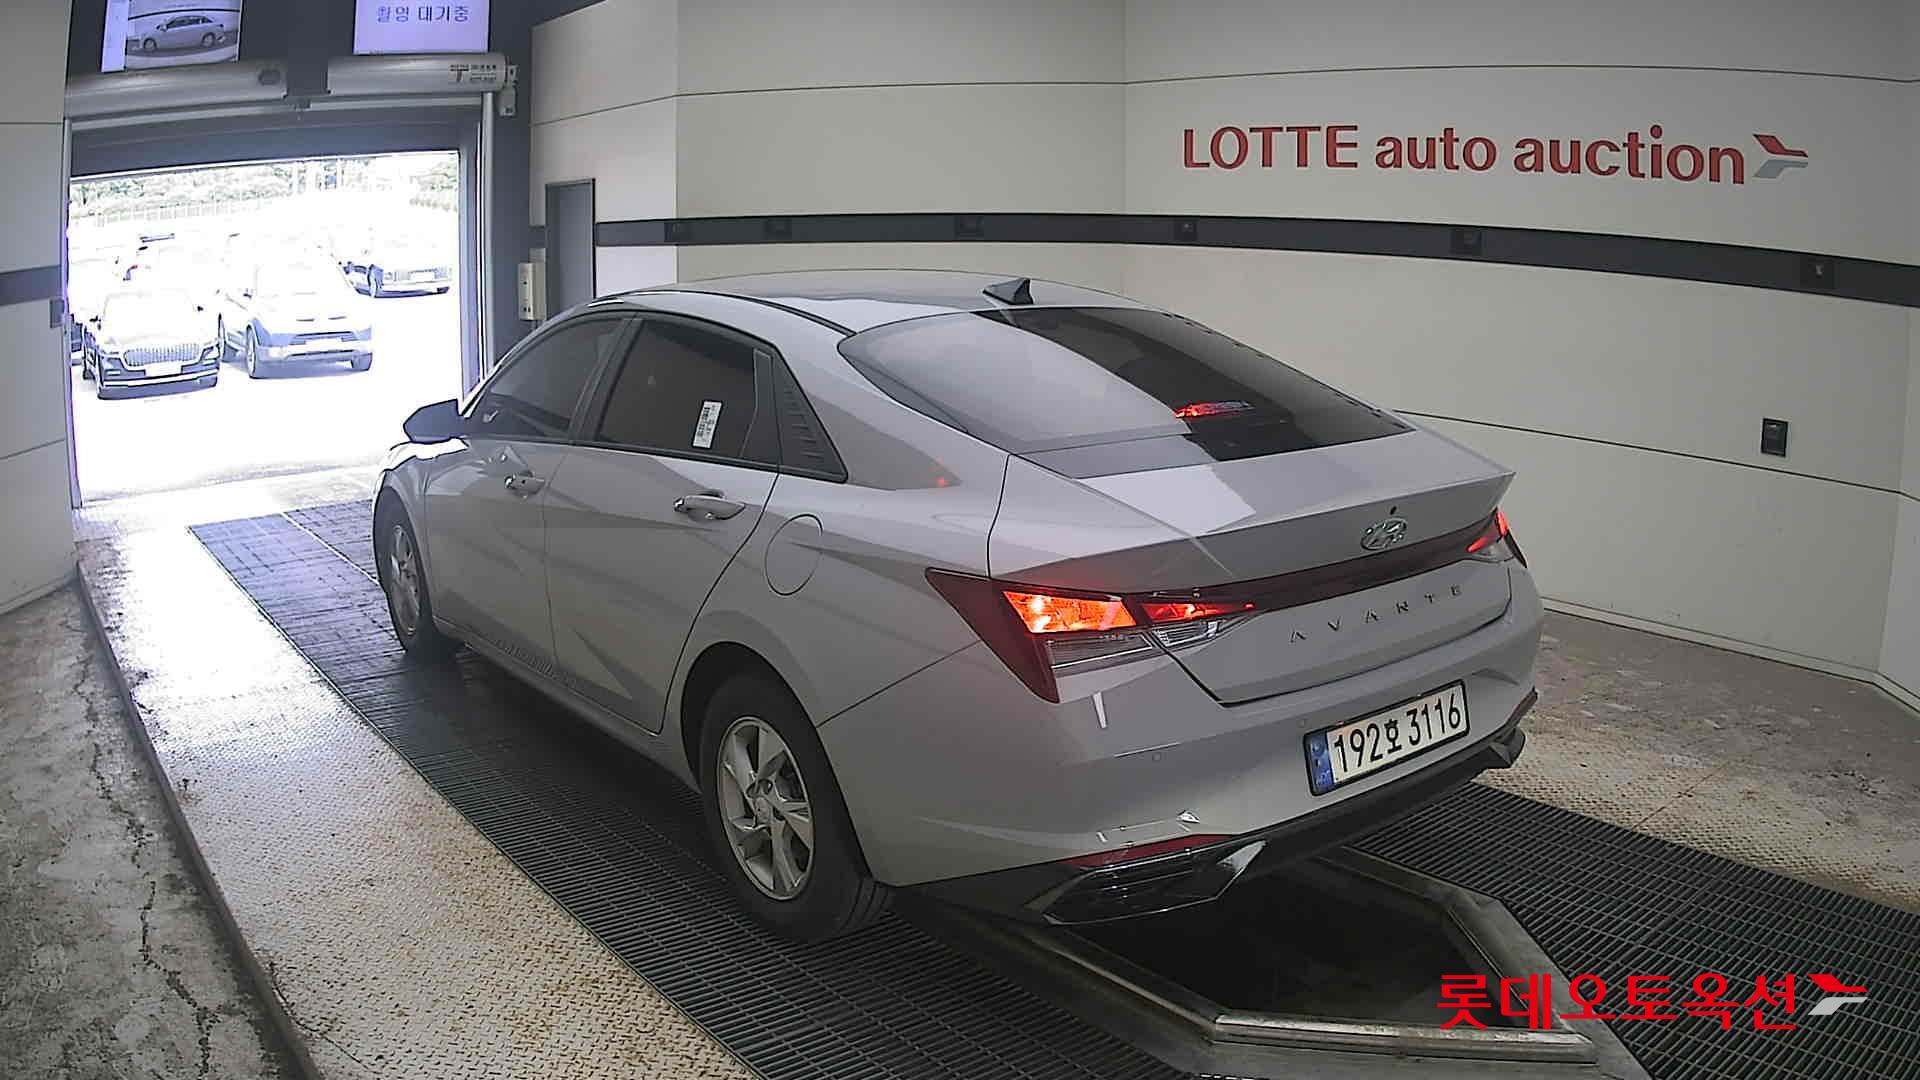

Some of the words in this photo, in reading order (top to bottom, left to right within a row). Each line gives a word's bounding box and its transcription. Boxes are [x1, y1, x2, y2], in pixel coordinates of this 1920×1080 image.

[418, 5, 468, 22] 대기중
[1184, 125, 1358, 170] LOTTE
[1375, 127, 1497, 171] auto
[1513, 124, 1745, 185] auction
[1406, 693, 1462, 746] 3116
